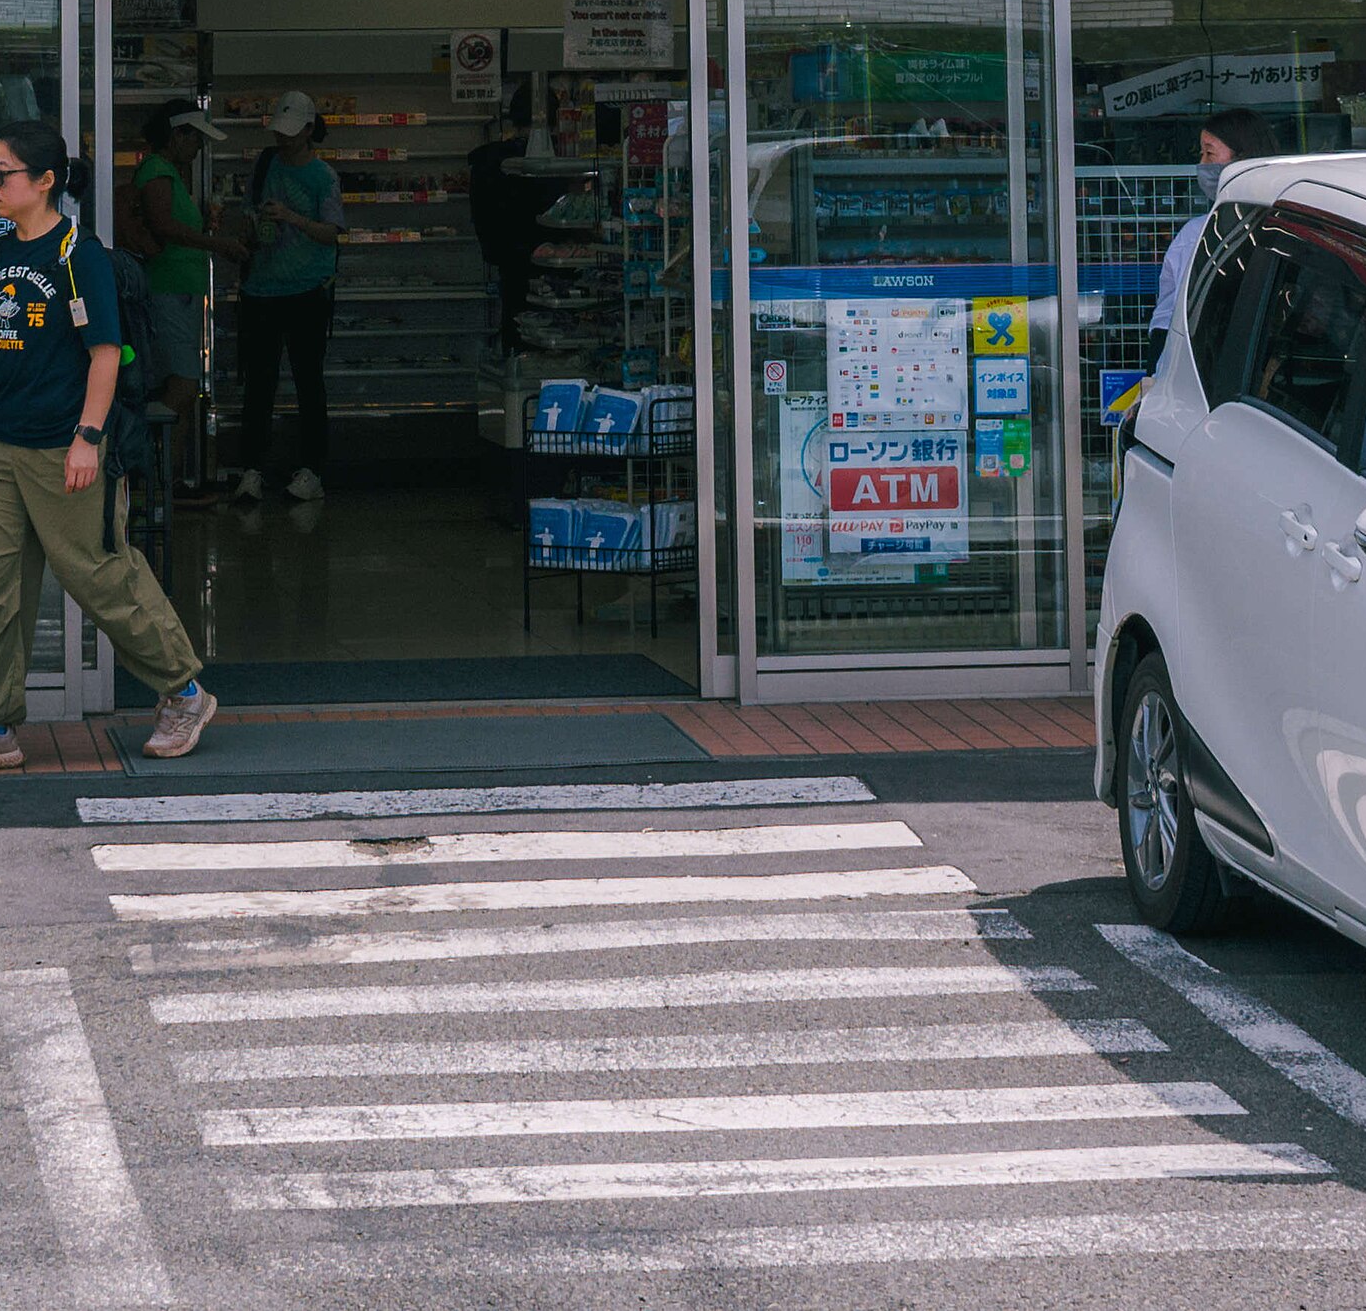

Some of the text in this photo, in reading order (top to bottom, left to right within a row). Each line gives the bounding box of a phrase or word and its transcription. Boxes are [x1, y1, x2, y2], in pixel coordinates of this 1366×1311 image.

[572, 10, 589, 20] You
[1113, 64, 1322, 112] この裏に菓子コーナーがあります
[8, 265, 30, 278] EST
[872, 275, 935, 287] LAWSON
[27, 313, 45, 327] 75
[978, 372, 1025, 382] インボイス
[987, 388, 1018, 400] 対象店
[829, 438, 959, 463] ローソン銀行
[852, 473, 939, 504] ATM
[906, 519, 946, 531] PayPay
[867, 541, 924, 550] チャージ可能
